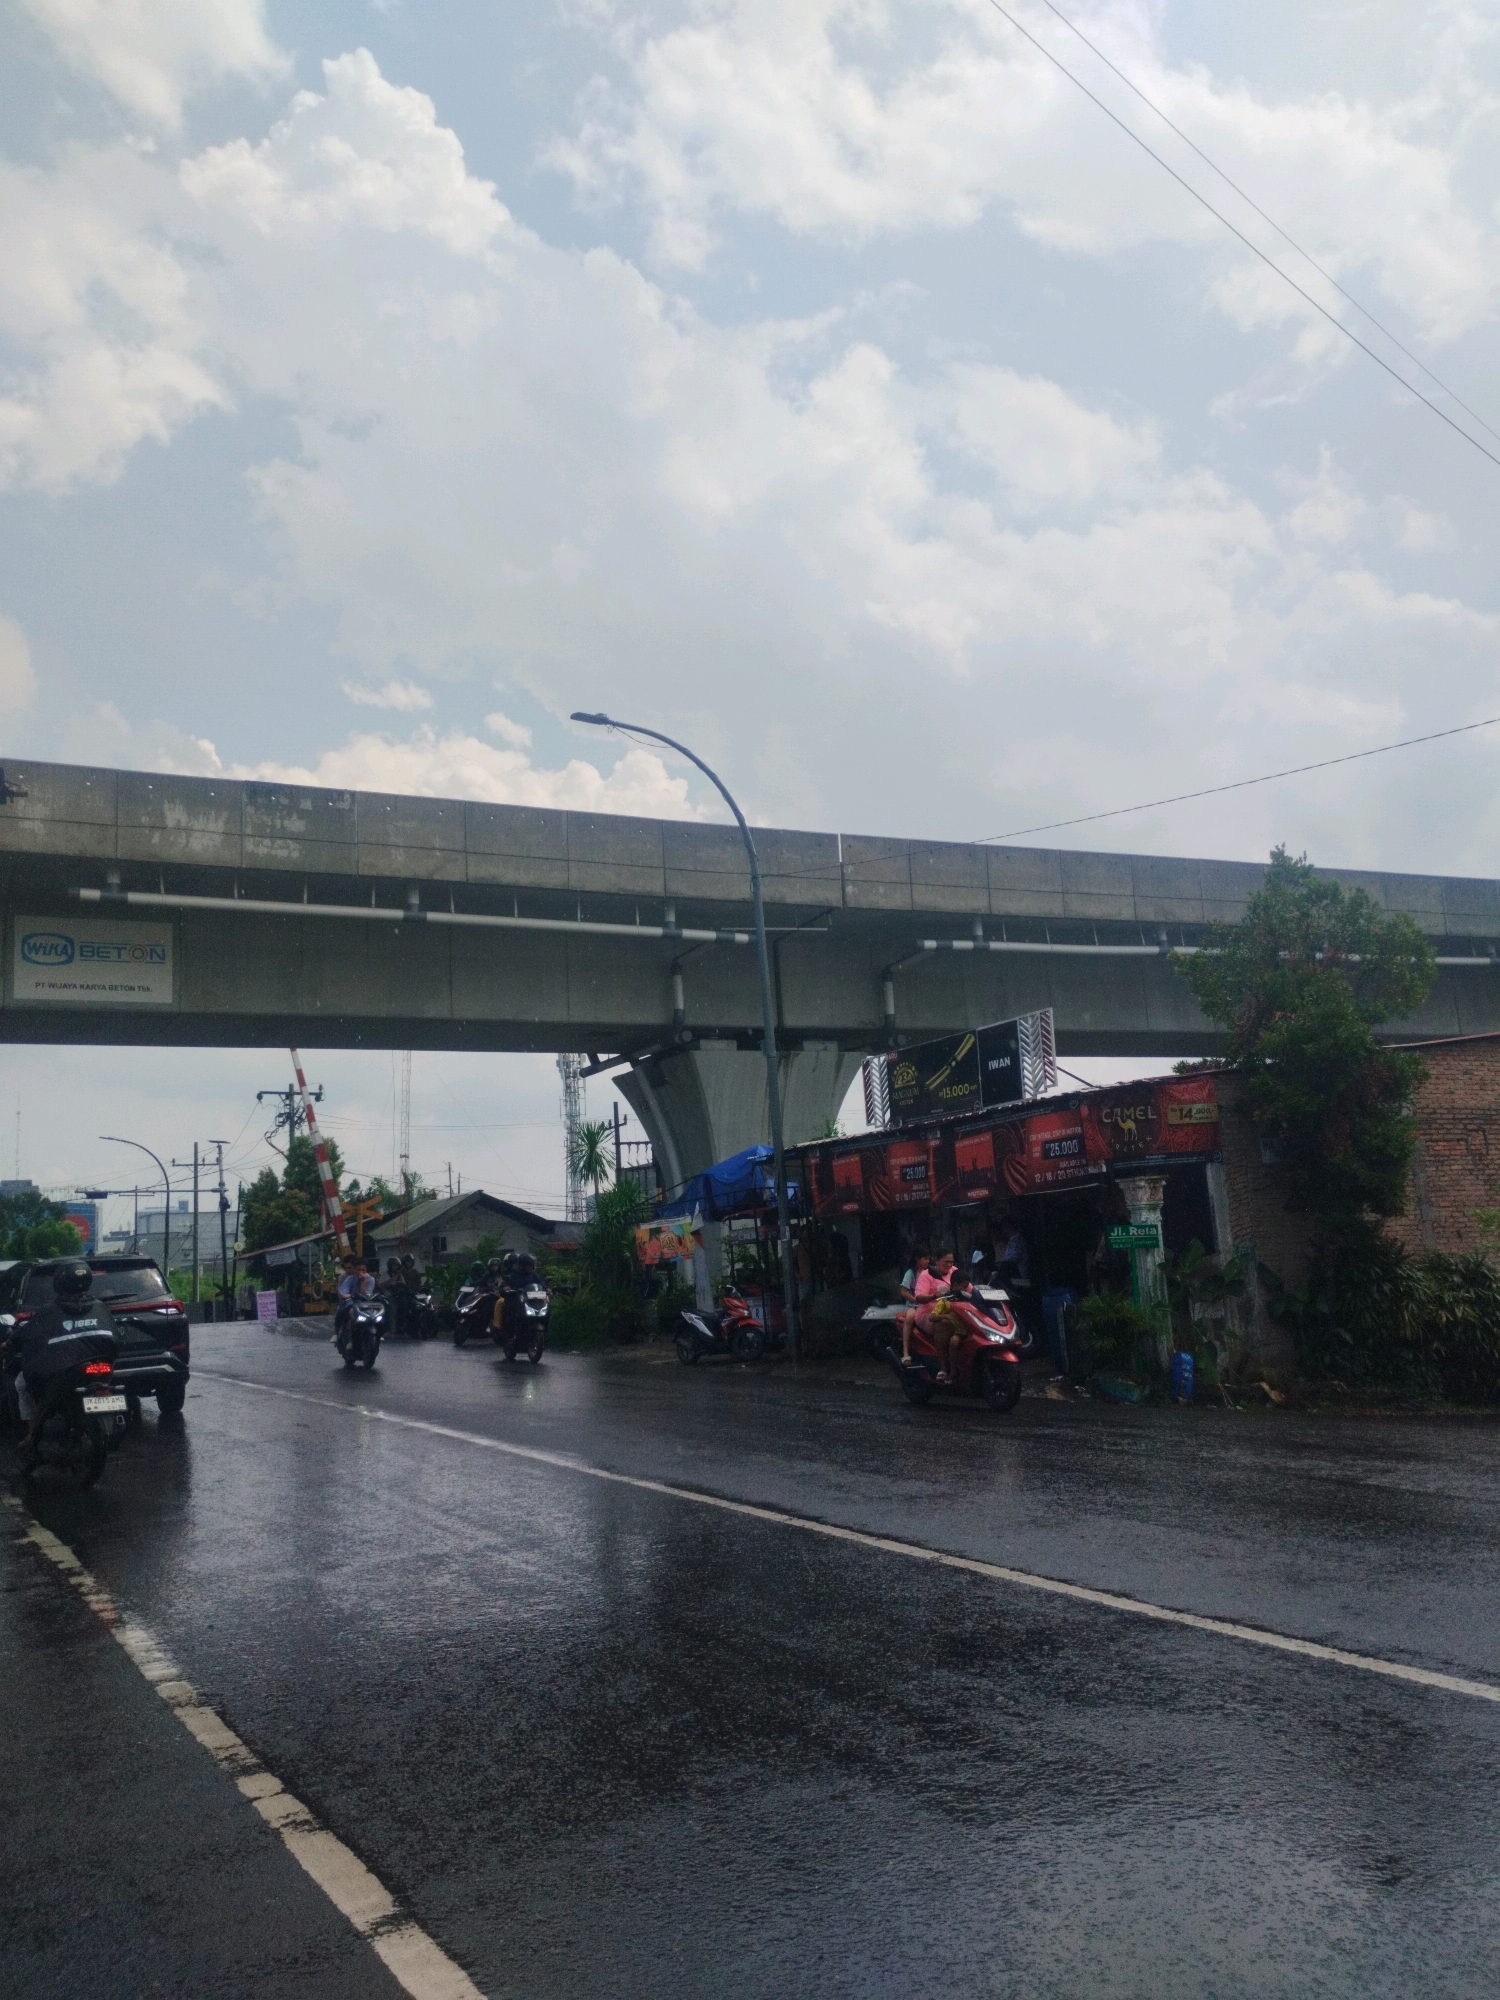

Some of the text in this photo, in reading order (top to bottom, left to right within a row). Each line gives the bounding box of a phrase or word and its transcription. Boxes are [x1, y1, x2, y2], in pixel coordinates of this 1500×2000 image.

[80, 944, 166, 961] BETON
[48, 982, 77, 990] WIJAYA
[80, 983, 107, 991] KARYA
[109, 984, 136, 992] BETON
[988, 1056, 1011, 1071] IWAN
[1101, 1105, 1157, 1123] CAMEL
[1110, 1226, 1157, 1236] Jl. Rela
[74, 1318, 98, 1328] IBEX
